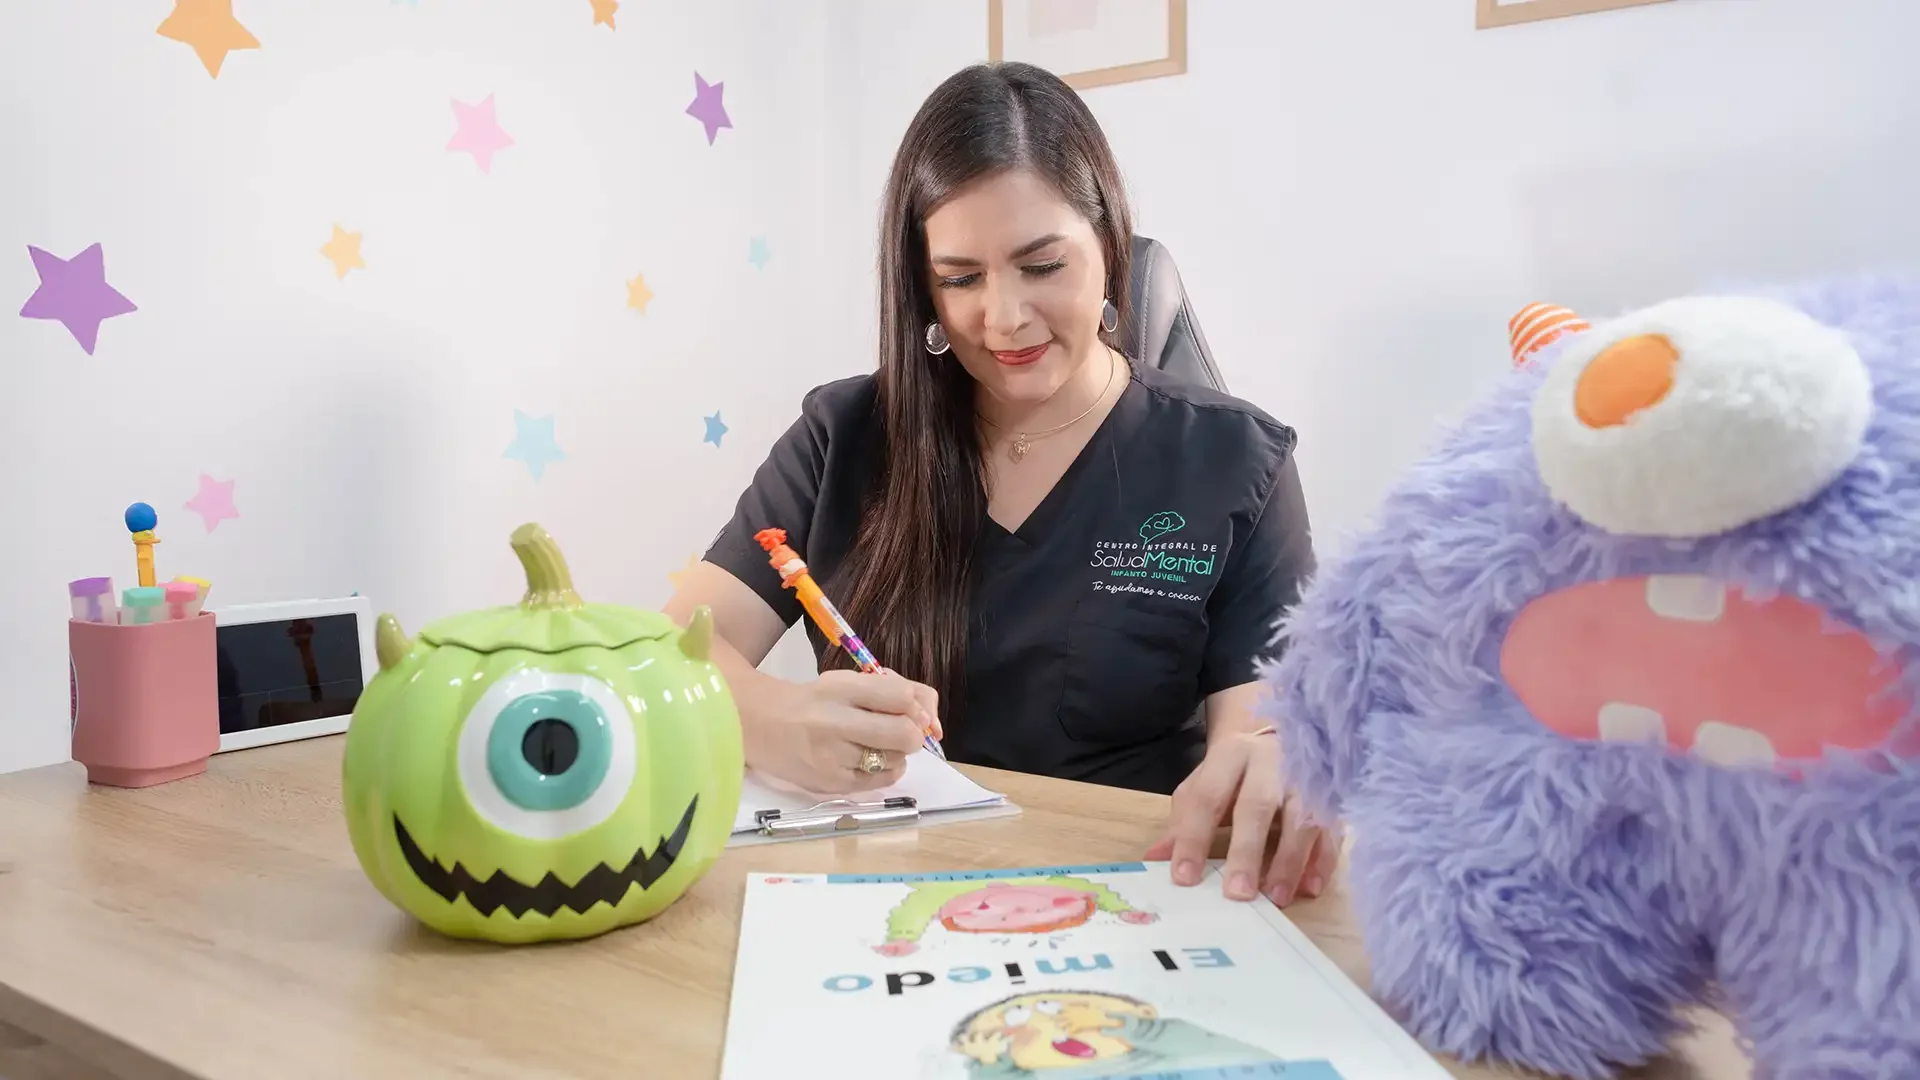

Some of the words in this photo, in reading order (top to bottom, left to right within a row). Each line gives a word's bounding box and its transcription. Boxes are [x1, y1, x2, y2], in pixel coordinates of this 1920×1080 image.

[1096, 541, 1138, 550] CENTRO
[1142, 542, 1196, 551] INTEGRAL
[1202, 544, 1217, 552] DE
[1111, 570, 1147, 578] INFANTO
[1150, 572, 1187, 583] JUVENIL
[1092, 581, 1103, 591] Te
[1105, 583, 1155, 596] ayudamos
[1168, 591, 1202, 602] crecer
[1152, 947, 1236, 971] El
[822, 953, 1114, 996] miedo
